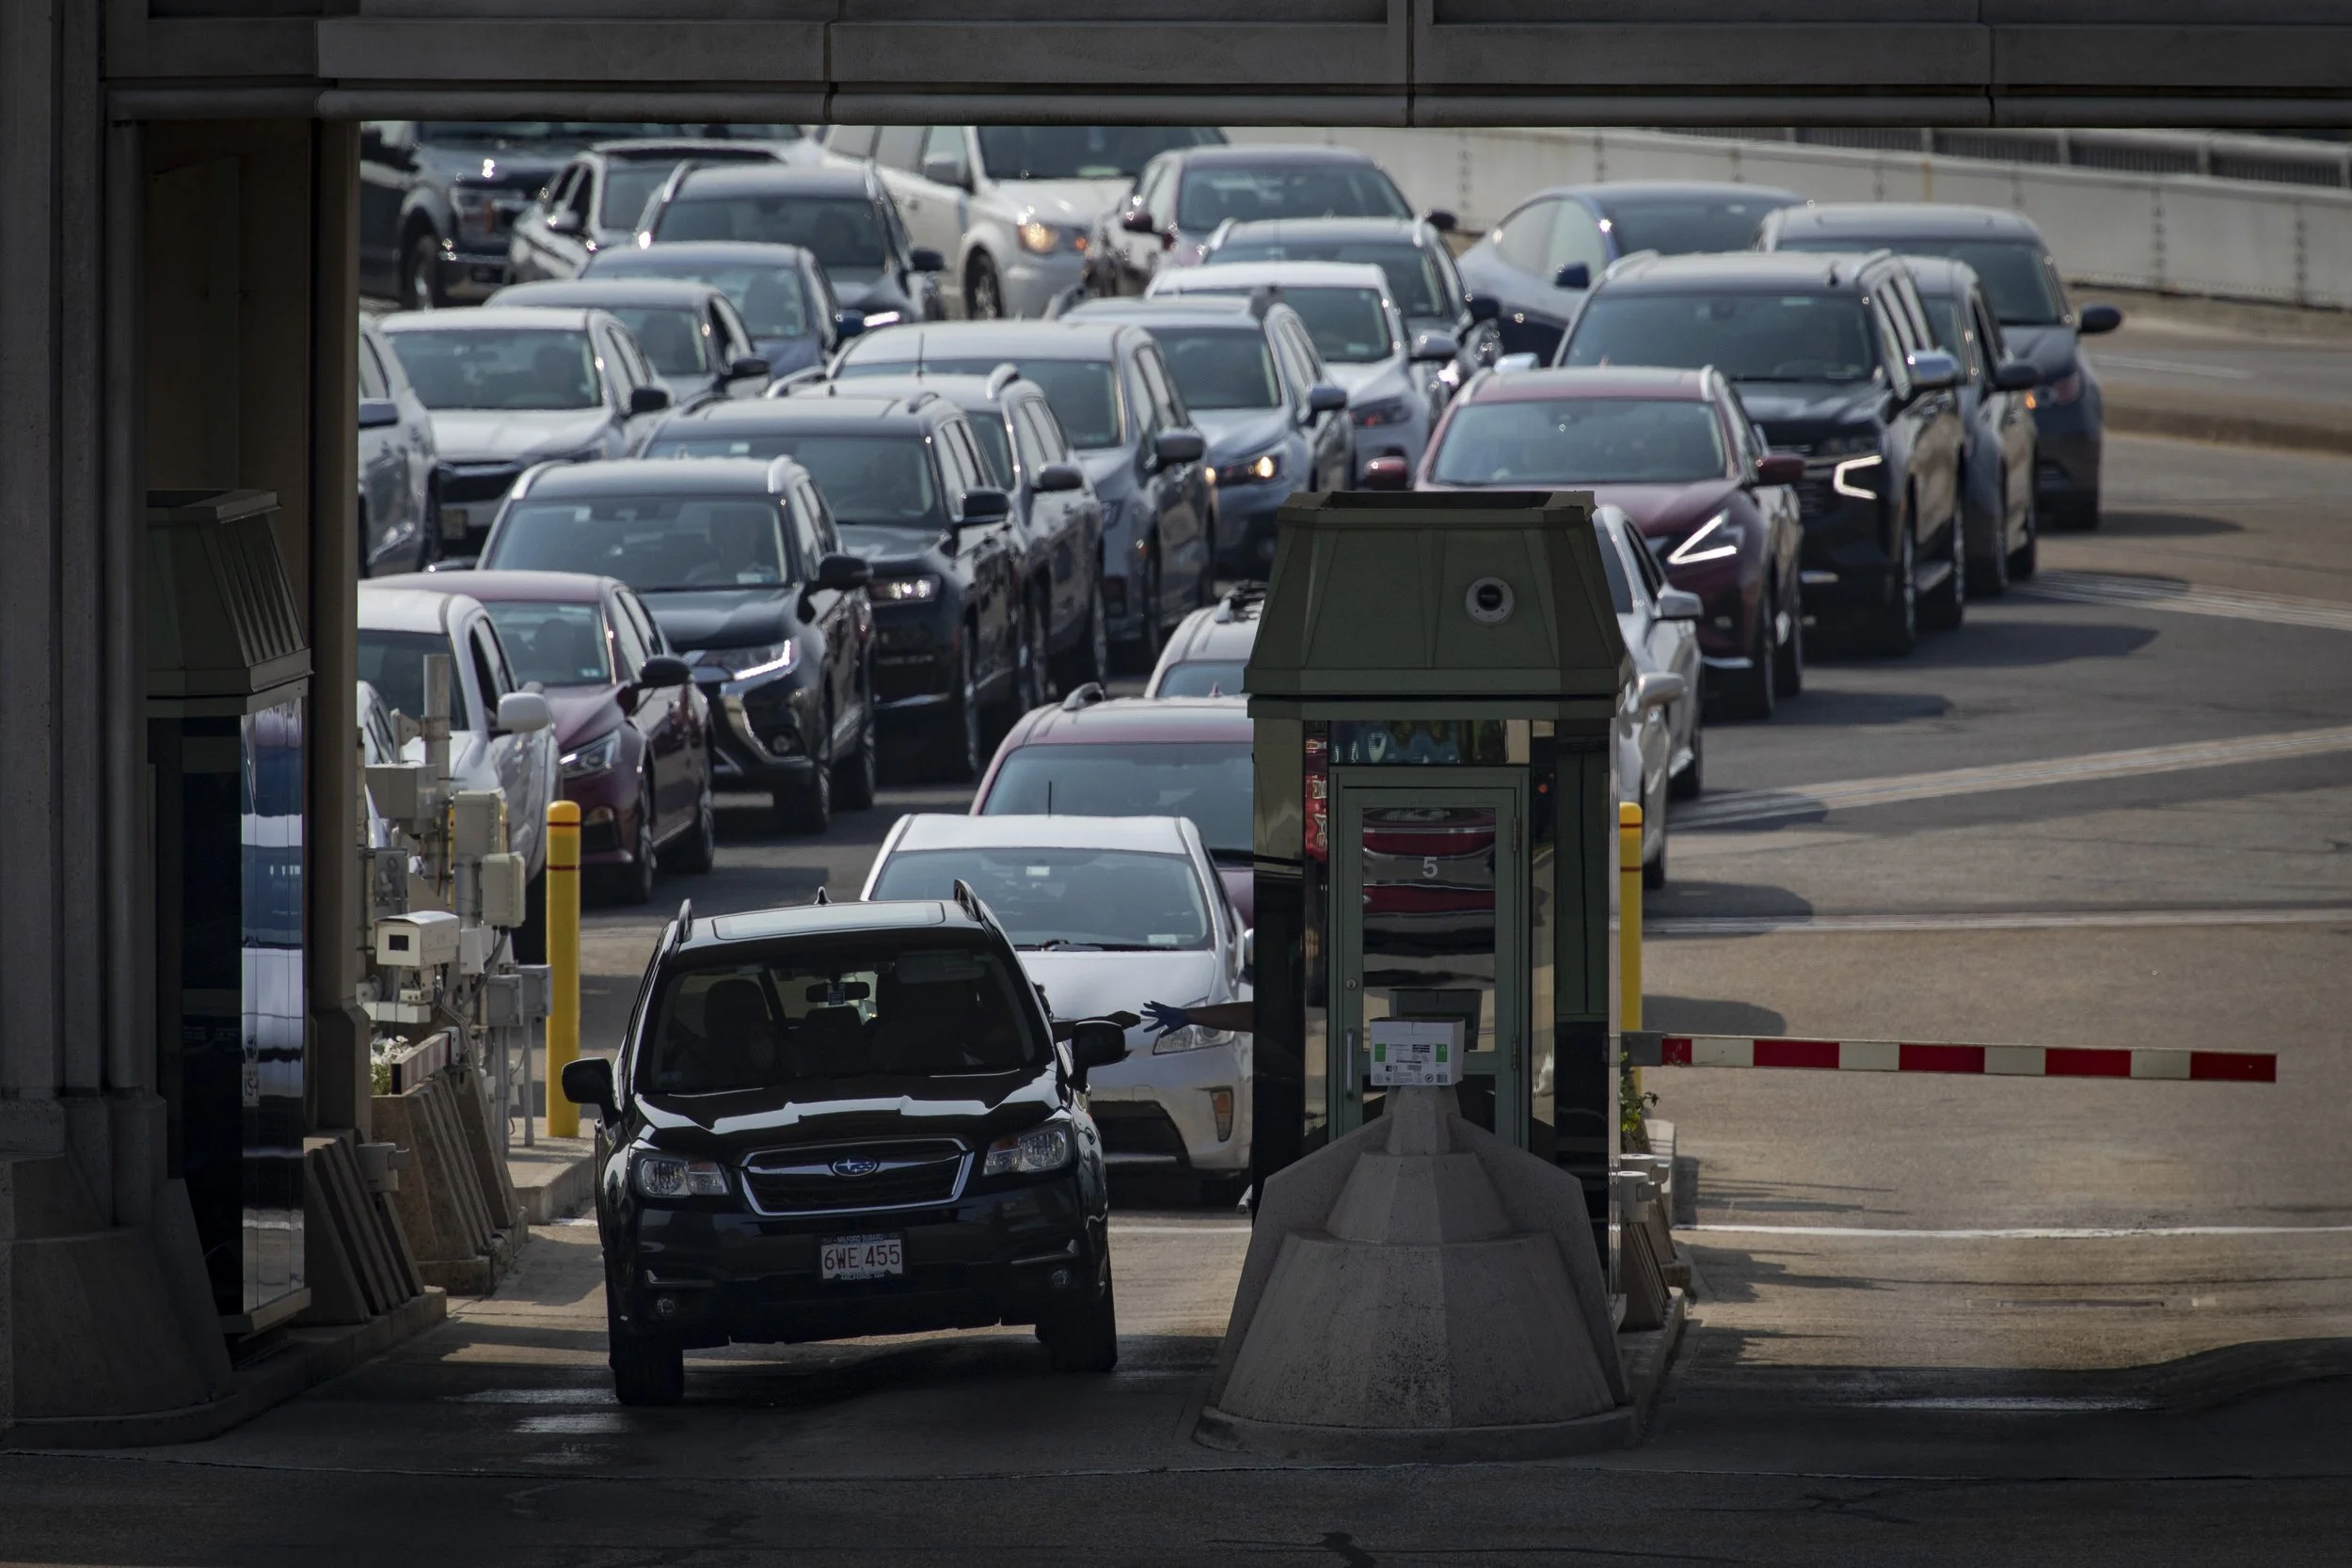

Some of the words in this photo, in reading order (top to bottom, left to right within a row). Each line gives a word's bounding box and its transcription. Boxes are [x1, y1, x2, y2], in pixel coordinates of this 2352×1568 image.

[1422, 856, 1438, 878] 5
[824, 1247, 859, 1270] 6WE
[865, 1243, 900, 1267] 455
